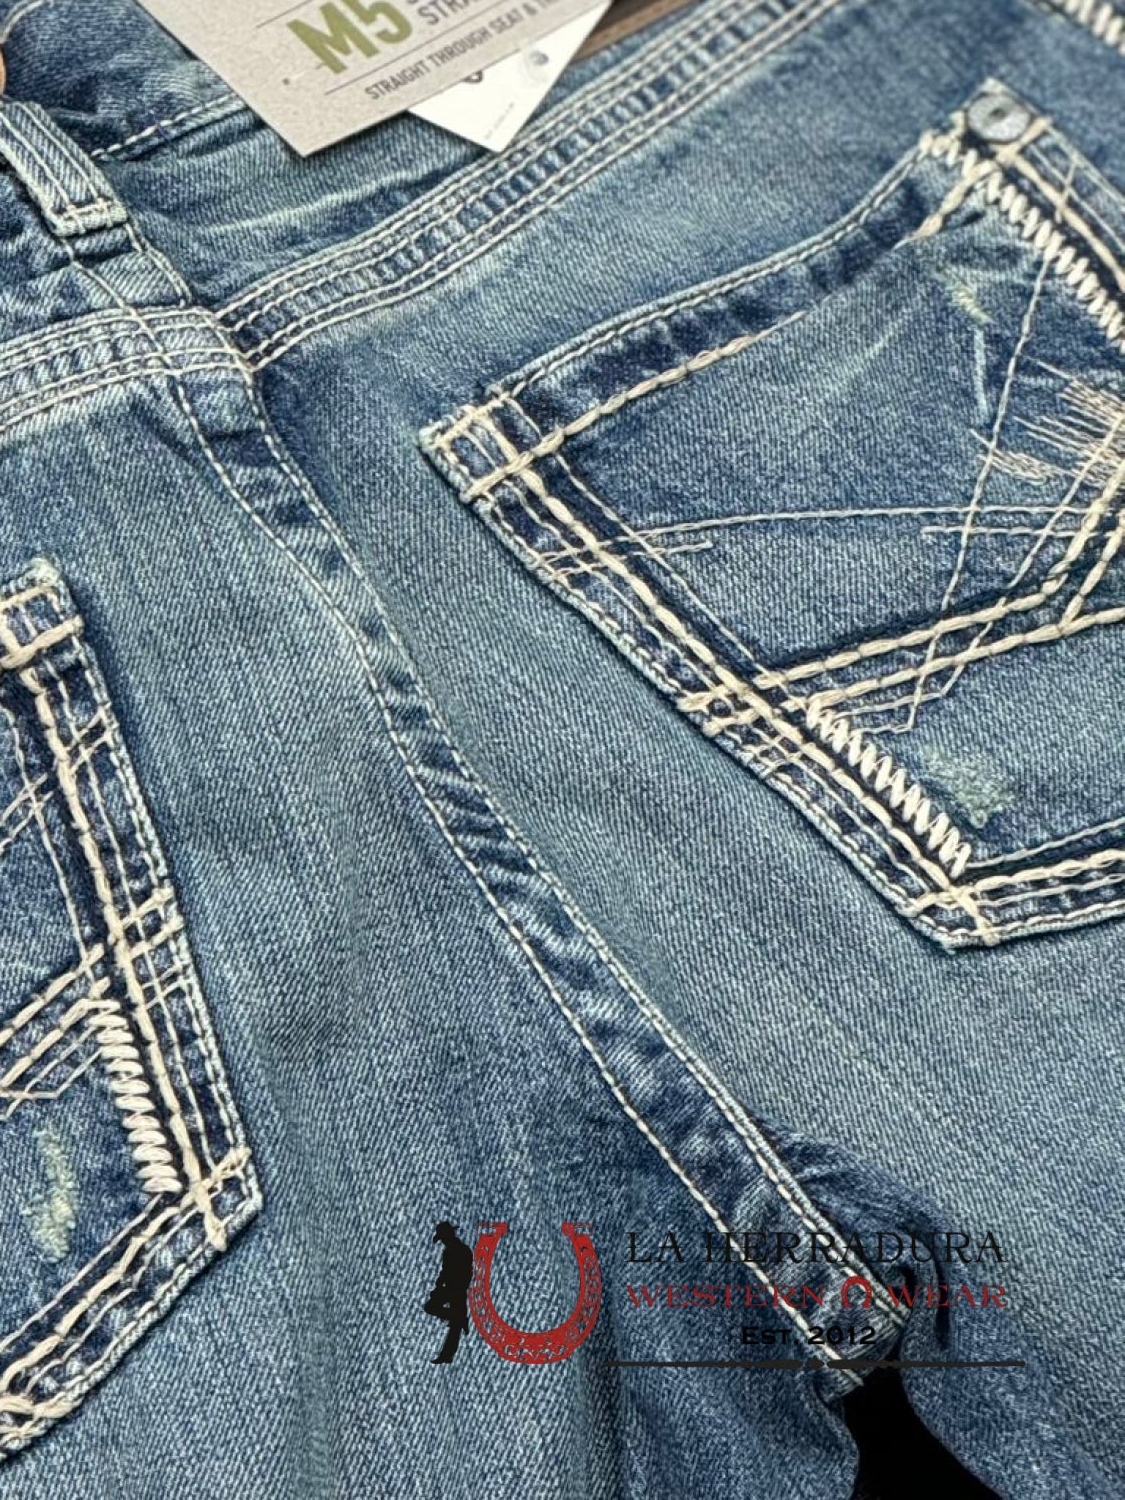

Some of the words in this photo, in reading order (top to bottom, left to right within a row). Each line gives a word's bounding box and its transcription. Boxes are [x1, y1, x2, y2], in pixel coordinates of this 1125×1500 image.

[364, 60, 431, 100] STRAIGHT
[427, 27, 492, 68] THROUGH
[488, 7, 525, 35] SEAT
